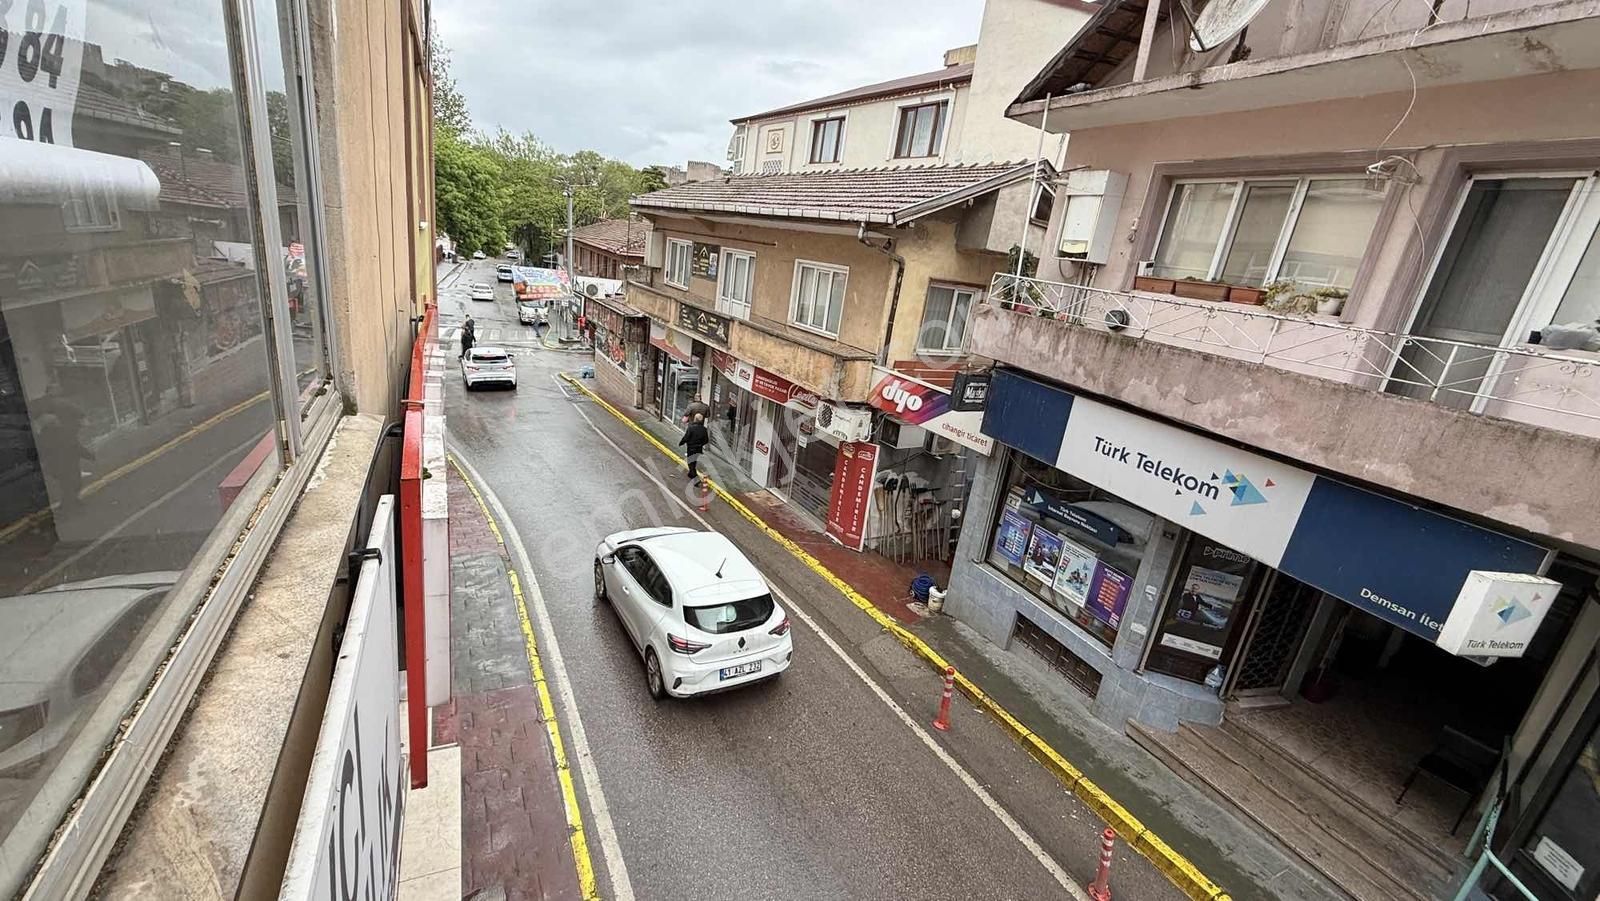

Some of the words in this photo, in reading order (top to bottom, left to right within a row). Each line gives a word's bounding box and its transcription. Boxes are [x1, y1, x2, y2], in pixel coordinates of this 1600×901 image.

[882, 379, 923, 414] dyo
[942, 422, 966, 438] cihangir
[967, 433, 988, 447] ticaret
[1095, 436, 1131, 464] Türk
[1136, 452, 1220, 500] Telekom
[1360, 587, 1416, 620] Demsan
[1419, 612, 1446, 633] İlet
[1466, 639, 1487, 649] Türk
[1487, 639, 1524, 650] Telekom
